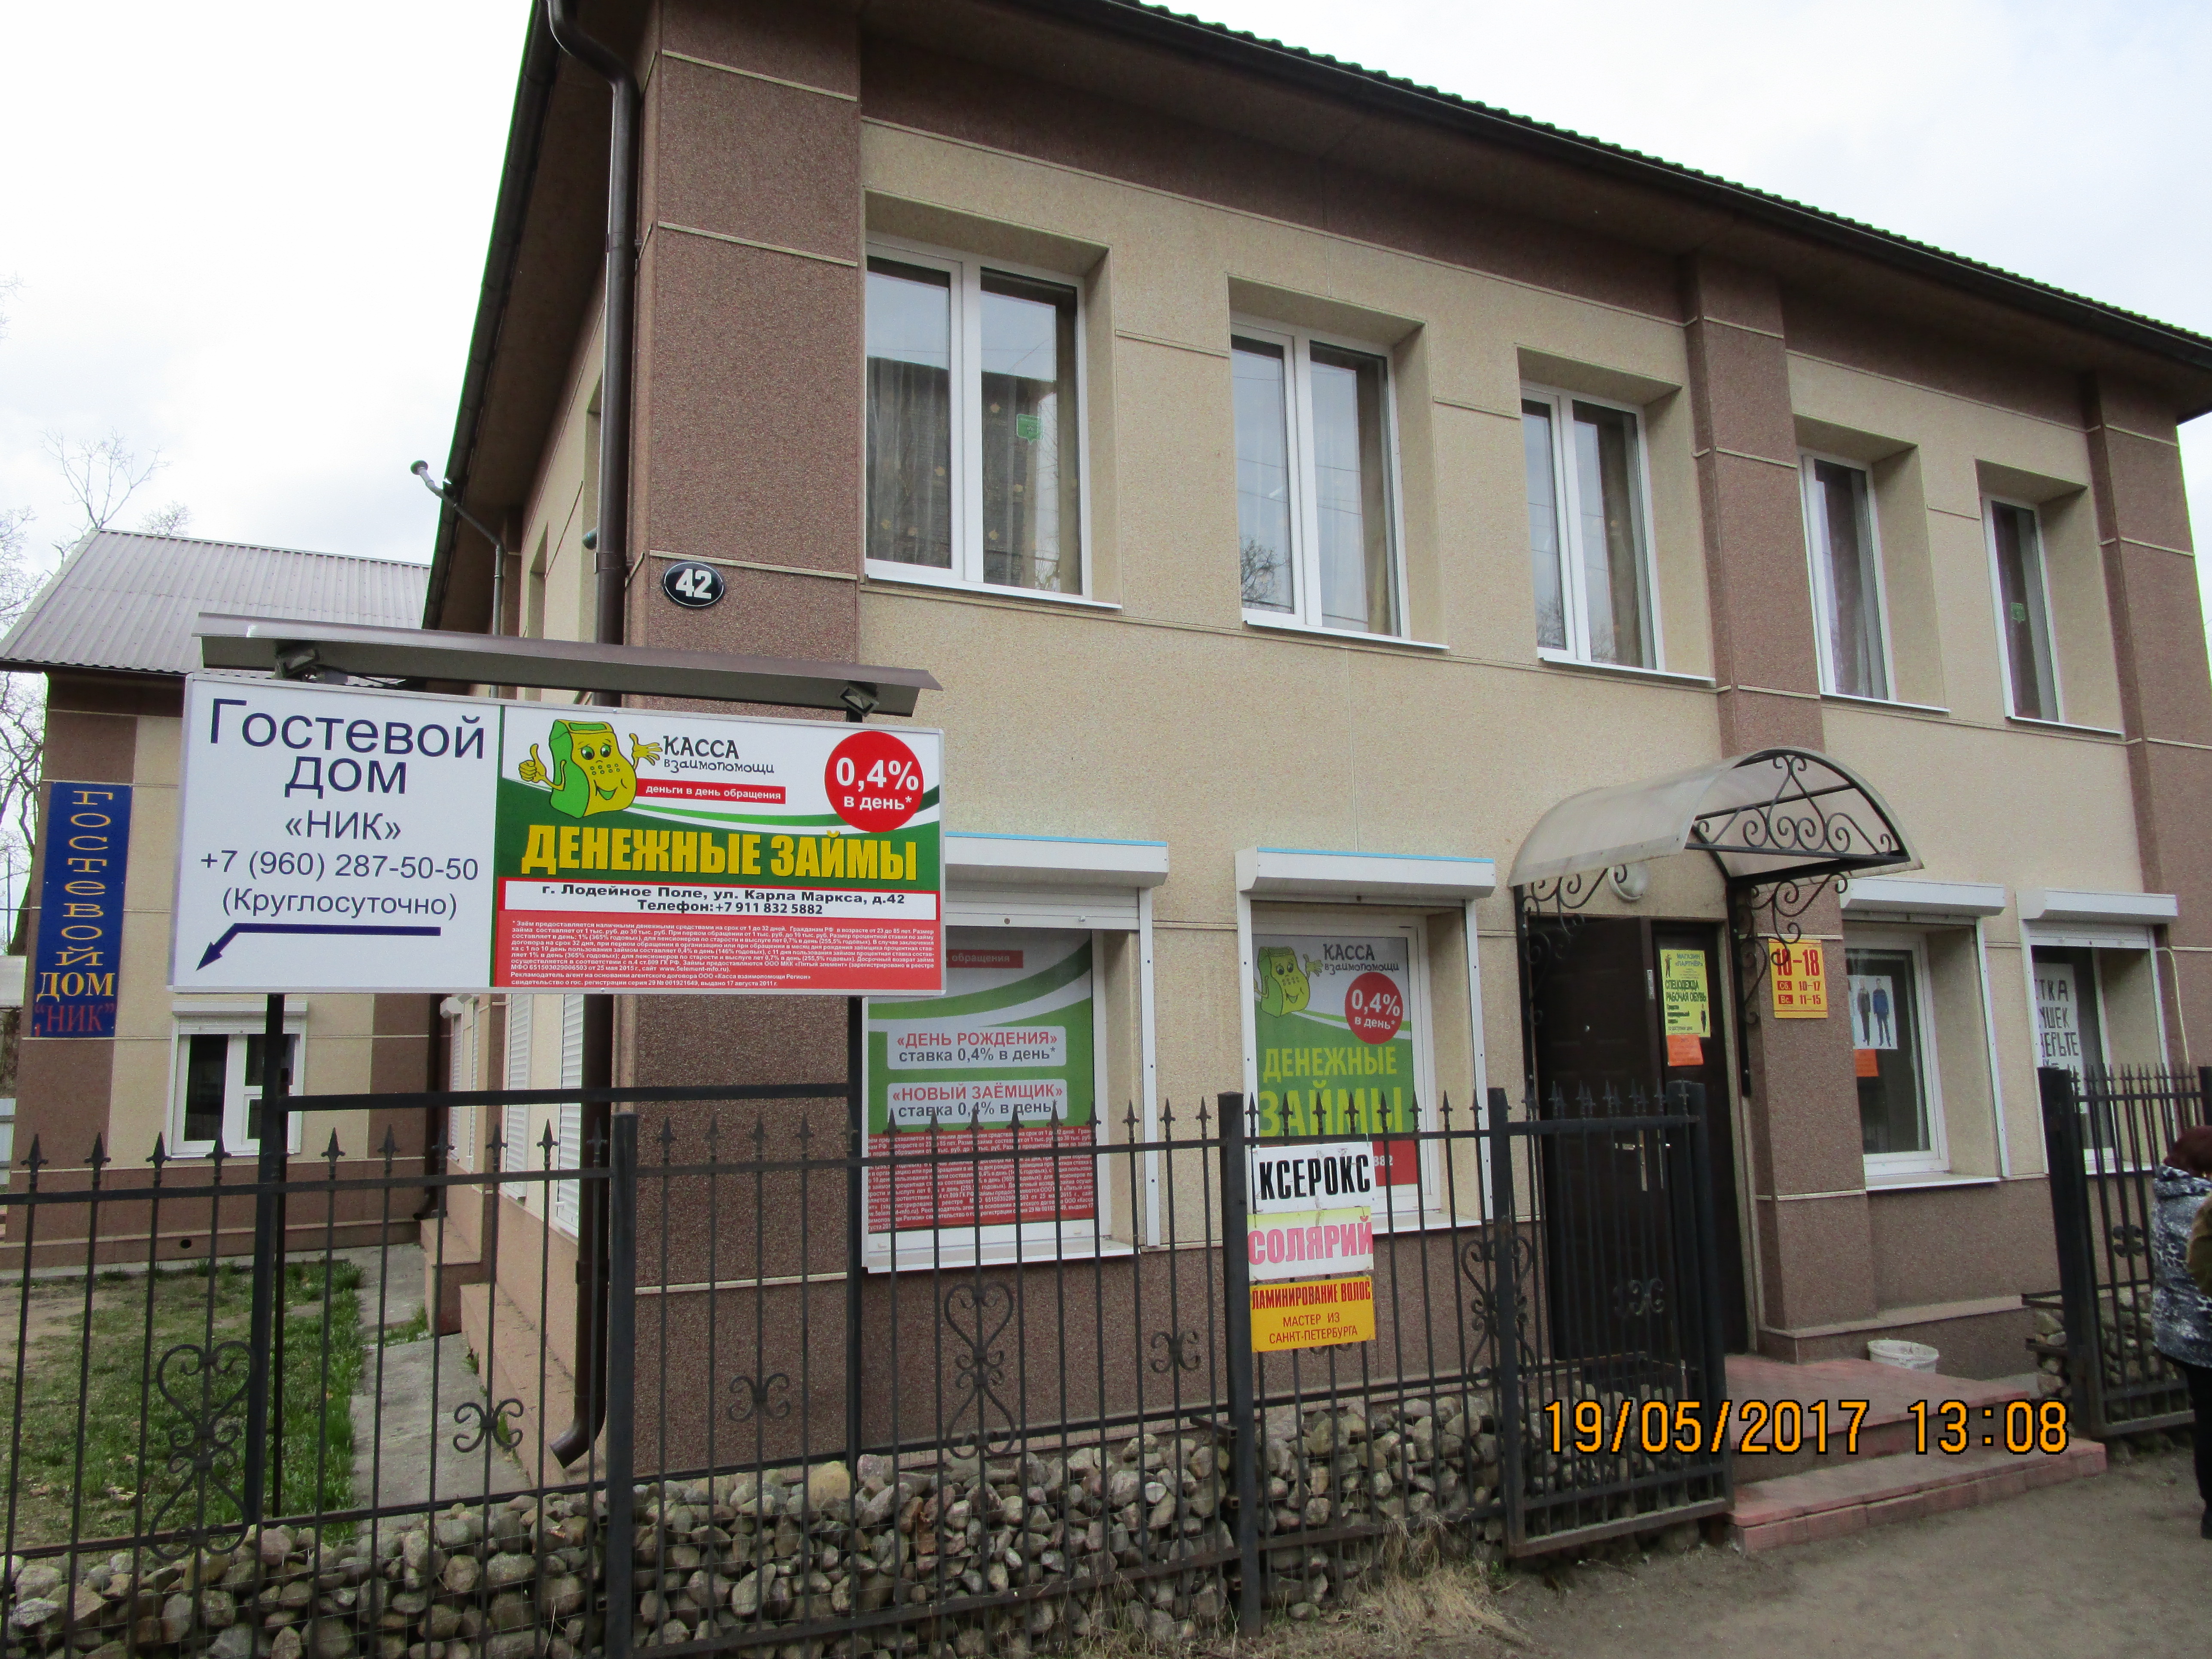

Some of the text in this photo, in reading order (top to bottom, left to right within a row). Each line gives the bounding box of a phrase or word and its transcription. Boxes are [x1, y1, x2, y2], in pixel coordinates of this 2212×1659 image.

[676, 568, 711, 599] 42
[210, 699, 484, 759] Гостевой
[663, 735, 739, 760] КАССА
[664, 758, 775, 775] взаимопомощи
[836, 757, 919, 792] 0,4%
[646, 785, 683, 794] деньги
[724, 789, 781, 799] обращения
[844, 796, 854, 807] в
[285, 810, 401, 840] «НИК»
[521, 824, 916, 880] ДЕНЕЖНЫЕ ЗАЙМЫ
[201, 850, 478, 881] +7 (960) 287-50-50
[222, 887, 458, 920] (Круглосуточно)
[542, 884, 905, 905] г. Лодейное Поле, ул. Карла Маркса, д.42
[736, 903, 759, 913] 911
[764, 903, 787, 914] 832
[791, 904, 823, 915] 5882
[952, 953, 1010, 963] обращения
[1323, 944, 1374, 961] КАССА
[1325, 963, 1400, 975] взаимопомощи
[2034, 979, 2069, 1002] ТКА
[1352, 989, 1400, 1017] 0,4%
[1355, 1017, 1361, 1025] в
[897, 1032, 1057, 1048] «ДЕНЬ РОЖДЕНИЯ»
[899, 1051, 952, 1062] ставка
[958, 1047, 994, 1062] 0,4%
[999, 1051, 1008, 1060] в
[1263, 1046, 1397, 1083] ДЕНЕЖНЫЕ
[893, 1082, 1063, 1101] «НОВЫЙ ЗАЁМЩИК»
[899, 1106, 952, 1117] ставка
[1000, 1104, 1009, 1113] в
[1259, 1080, 1403, 1137] ЗАЙМЫ
[1259, 1154, 1370, 1200] КСЕРОКС
[1248, 1215, 1373, 1265] СОЛЯРИЙ
[1252, 1280, 1370, 1310] ЛАМИНИРОВАНИЕ ВОЛОС
[1283, 1312, 1340, 1328] МАСТЕР ИЗ
[1269, 1325, 1358, 1344] САНКТ-ПЕТЕРБУРГА
